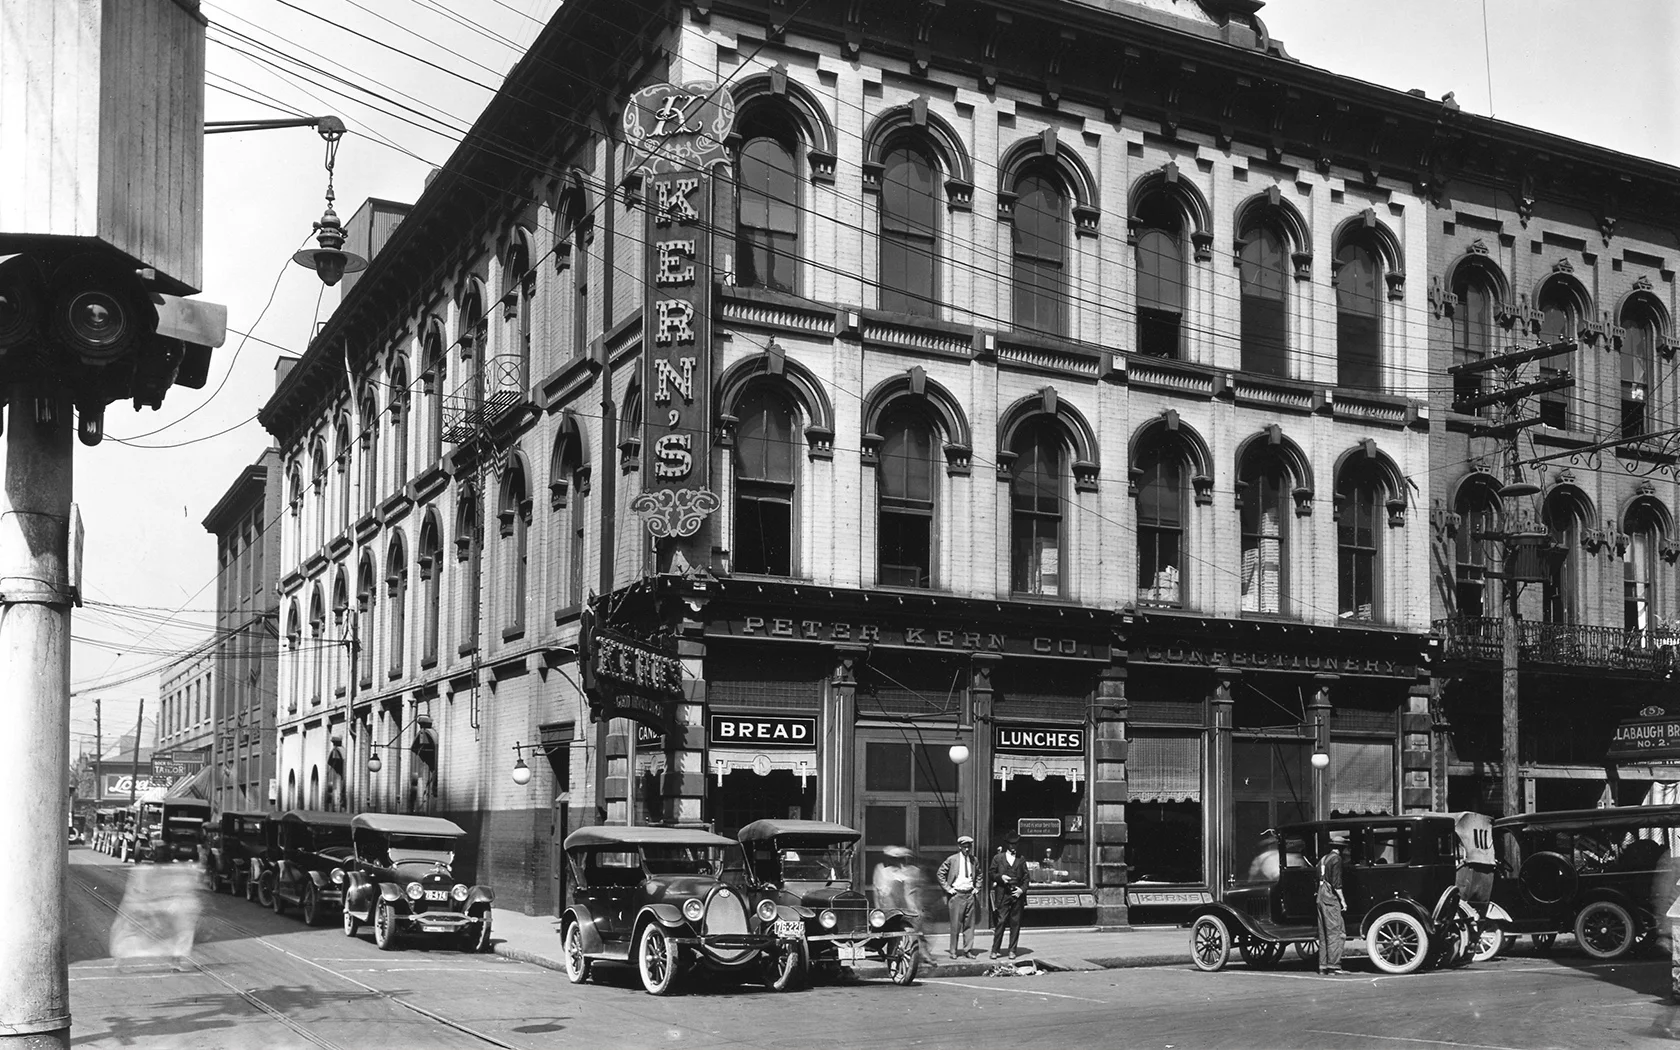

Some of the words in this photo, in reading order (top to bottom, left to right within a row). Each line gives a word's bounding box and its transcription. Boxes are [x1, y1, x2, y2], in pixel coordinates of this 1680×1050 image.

[655, 177, 699, 480] KERN'S
[743, 616, 880, 641] PETER
[905, 627, 1006, 649] KERN
[1033, 637, 1088, 655] CO.
[720, 722, 807, 739] BREAD
[1613, 725, 1664, 741] LABAUGH
[1001, 731, 1080, 747] LUNCHES
[1637, 740, 1655, 748] NO.
[1658, 738, 1670, 747] 2.
[1028, 896, 1077, 906] ERNS
